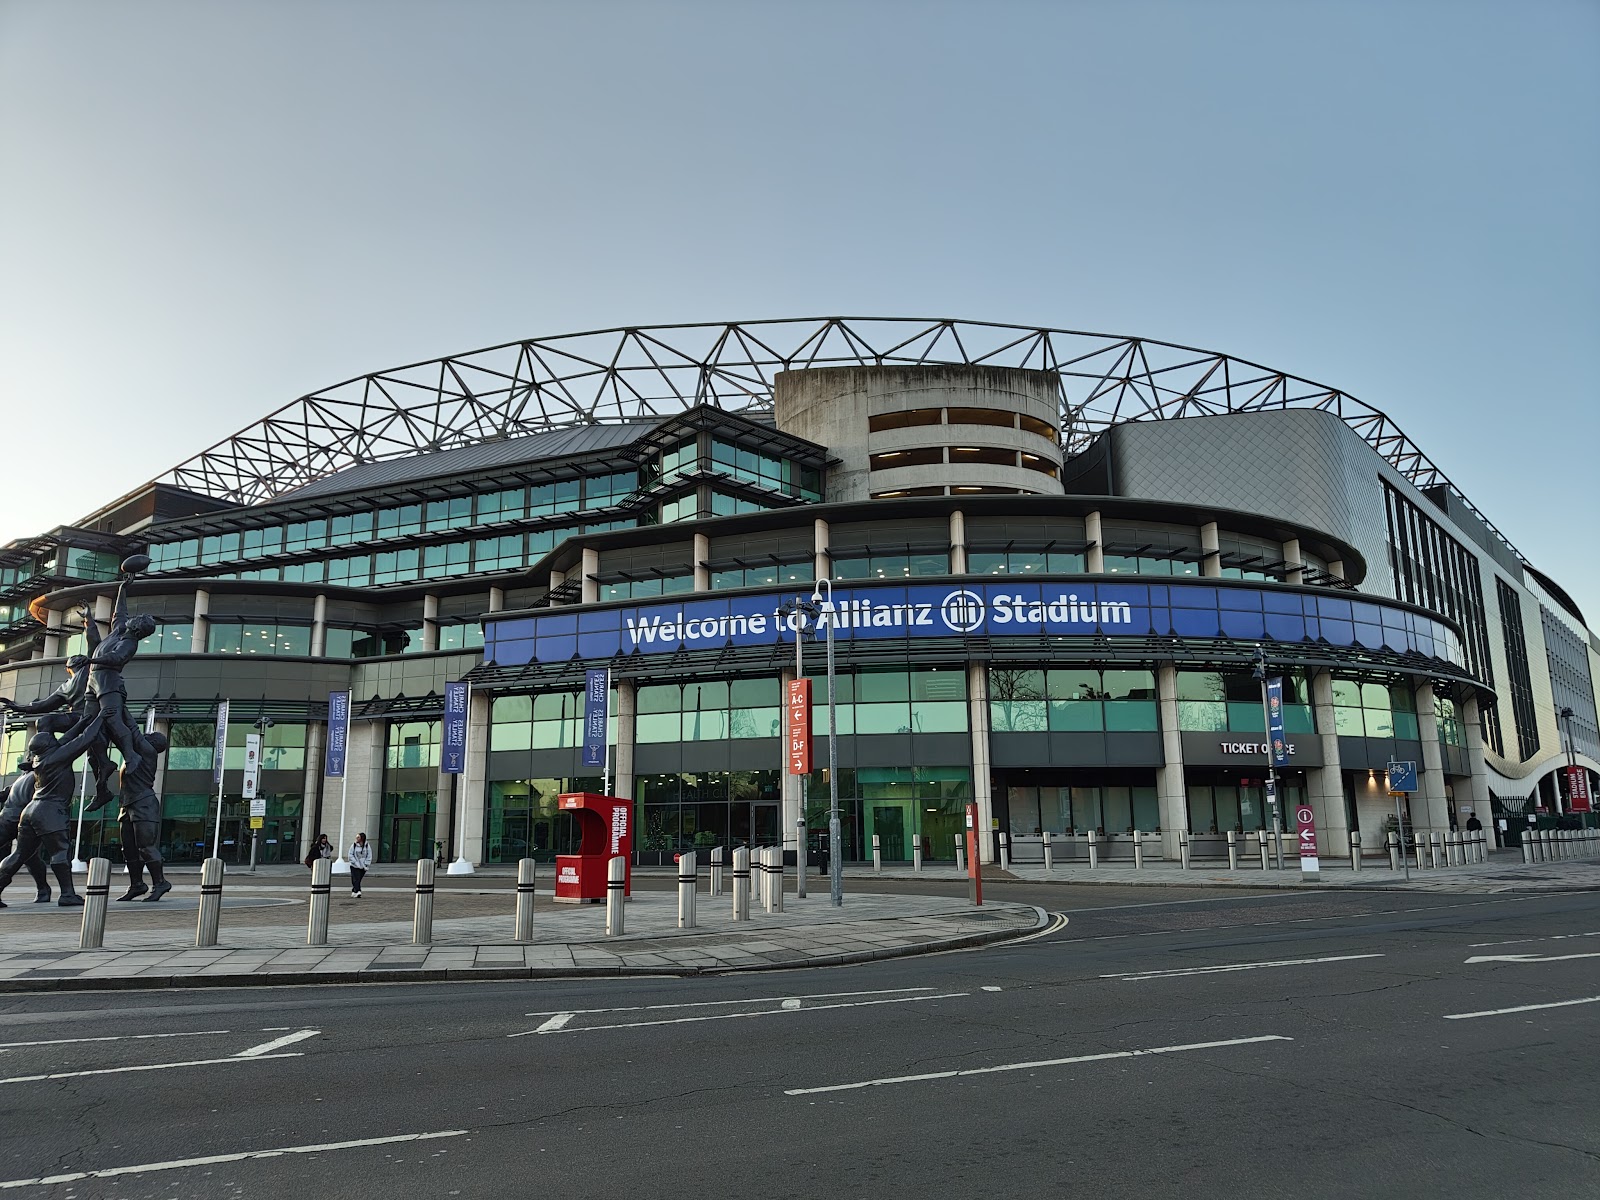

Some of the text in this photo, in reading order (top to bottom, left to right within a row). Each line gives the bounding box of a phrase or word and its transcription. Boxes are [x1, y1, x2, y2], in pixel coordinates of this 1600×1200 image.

[627, 594, 1131, 644] Welcome to Allianz Stadium
[792, 694, 803, 704] A-C
[793, 741, 804, 751] D-F
[1220, 742, 1259, 754] TICKET
[1570, 773, 1579, 799] STADIUM
[1577, 769, 1586, 799] ENTRANCE
[611, 807, 620, 854] PROGRAMME
[619, 807, 627, 838] OFFICIAL
